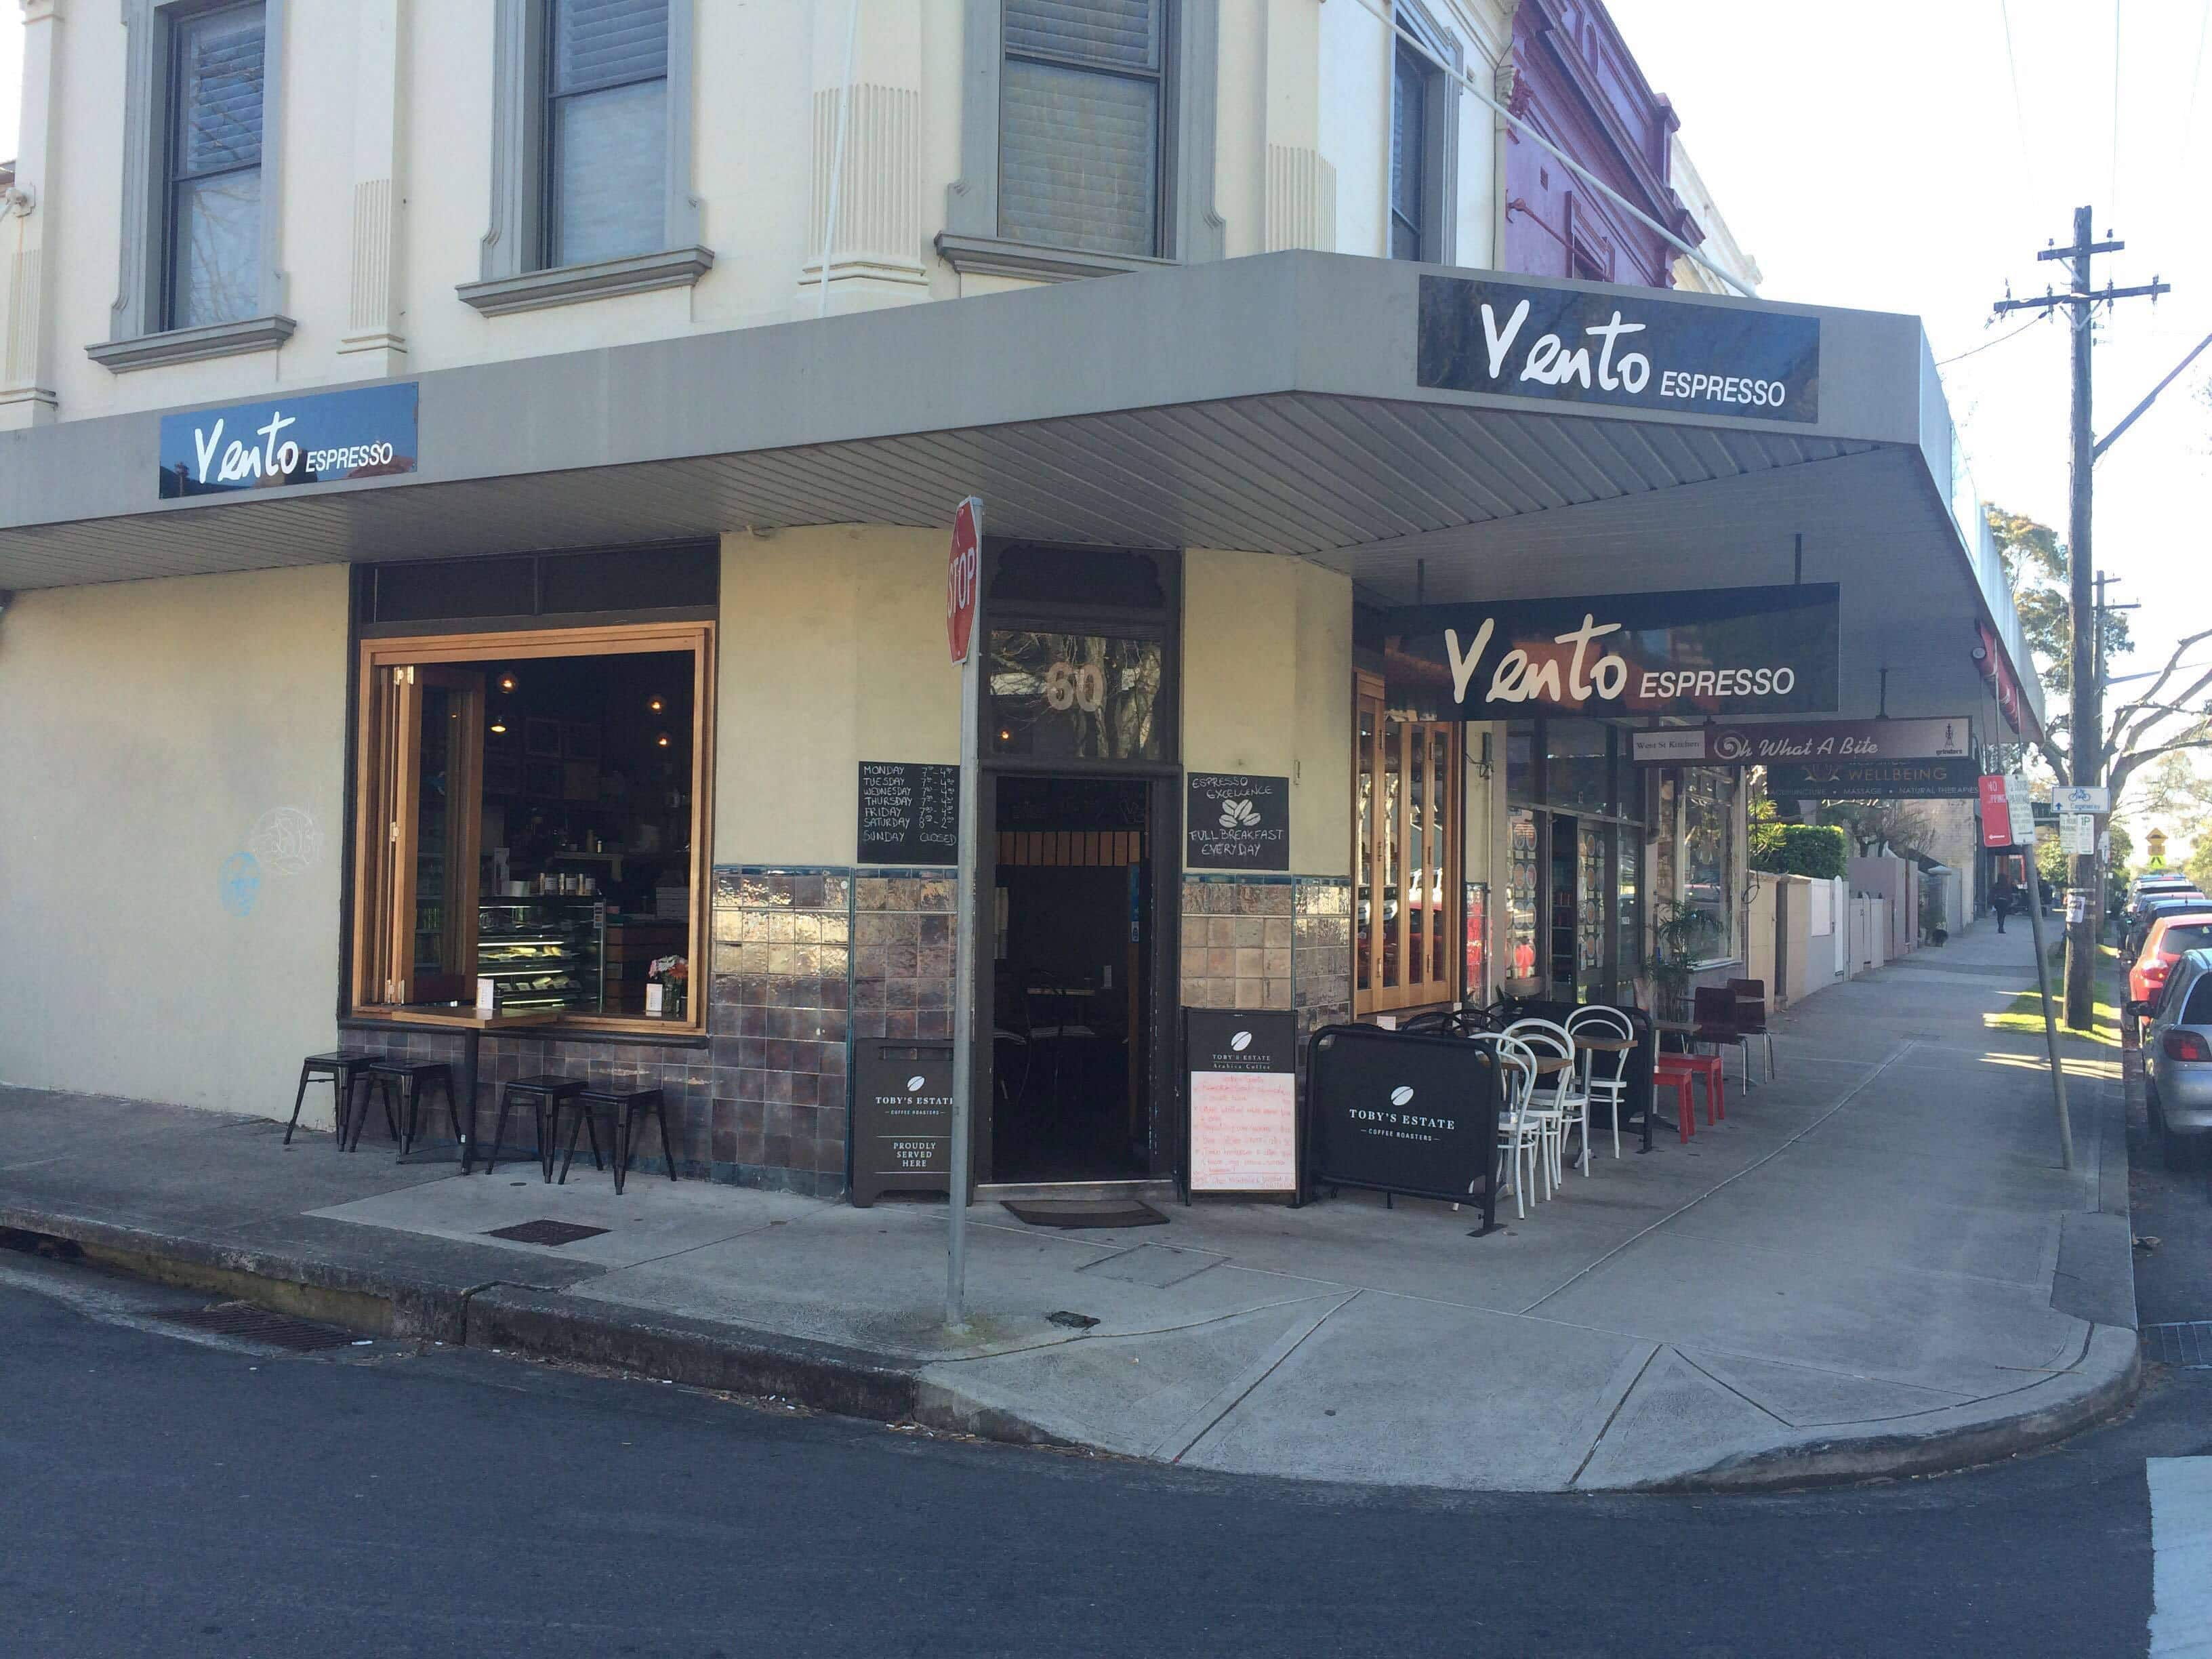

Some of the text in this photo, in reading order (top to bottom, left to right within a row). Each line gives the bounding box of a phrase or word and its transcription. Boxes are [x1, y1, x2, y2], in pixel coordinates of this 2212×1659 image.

[1481, 300, 1786, 407] Vento ESPRESSO
[194, 411, 393, 484] Vento ESPRESSO
[949, 547, 975, 618] STOP
[1444, 613, 1795, 703] Vento ESPRESSO
[1758, 737, 1811, 756] What
[1816, 737, 1833, 755] A
[1839, 736, 1879, 755] Bite
[863, 766, 905, 775] MONDAY
[1848, 767, 1948, 781] WELLBEING
[863, 777, 905, 786] TUESDAY
[1192, 777, 1248, 788] ESPRESSO
[1987, 780, 1998, 792] NO
[863, 787, 912, 796] WEDNESDAY
[1206, 785, 1273, 799] EXCELLENCE
[1843, 787, 1882, 796] MASSAGE
[1898, 787, 1936, 795] NATURAL
[864, 796, 913, 807] THURSDAY
[865, 806, 902, 817] FRIDAY
[863, 817, 911, 830] SATURDAY
[863, 830, 957, 846] SUNDAY CLOSED
[1189, 829, 1286, 841] FULL BREAKFAST
[875, 1096, 913, 1105] TOBY'S
[1349, 1108, 1456, 1130] TOBY'S ESTATE
[1368, 1128, 1433, 1142] COFFEE ROASTERS
[893, 1142, 937, 1150] PROUDLY
